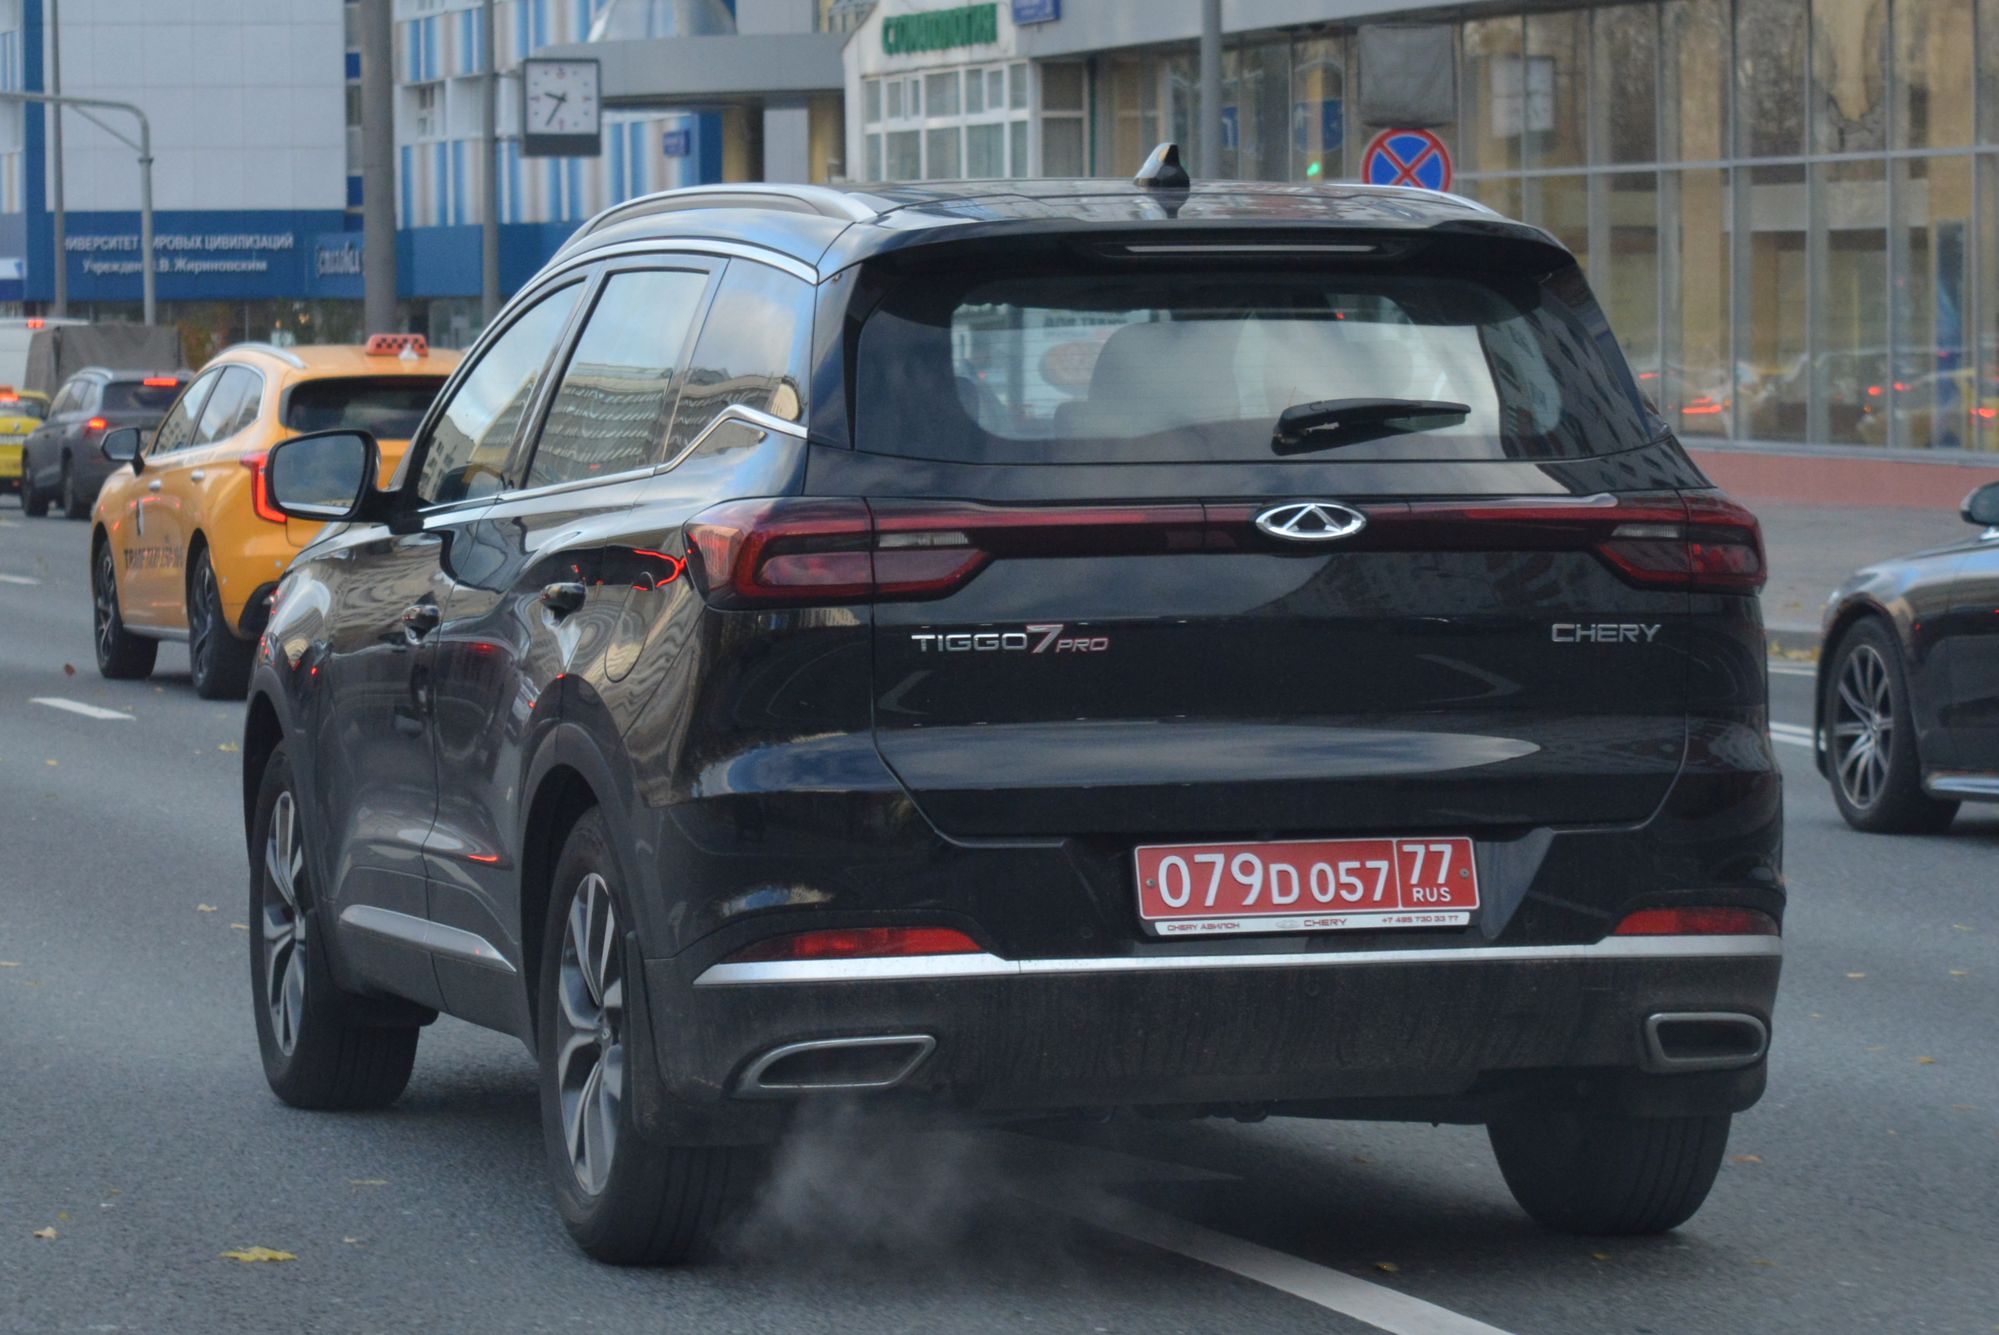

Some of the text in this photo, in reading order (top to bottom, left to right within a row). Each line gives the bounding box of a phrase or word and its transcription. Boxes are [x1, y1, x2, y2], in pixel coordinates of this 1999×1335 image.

[152, 235, 202, 250] ИРОВЫХ
[205, 232, 294, 251] ЦИВИЛИЗАЦИЙ
[174, 257, 268, 275] Жириновским
[911, 624, 1109, 653] TIGGO 7 PRO
[1552, 624, 1661, 642] CHERY
[1402, 844, 1452, 885] 77
[1413, 887, 1451, 902] RUS
[1304, 918, 1347, 927] CHERY
